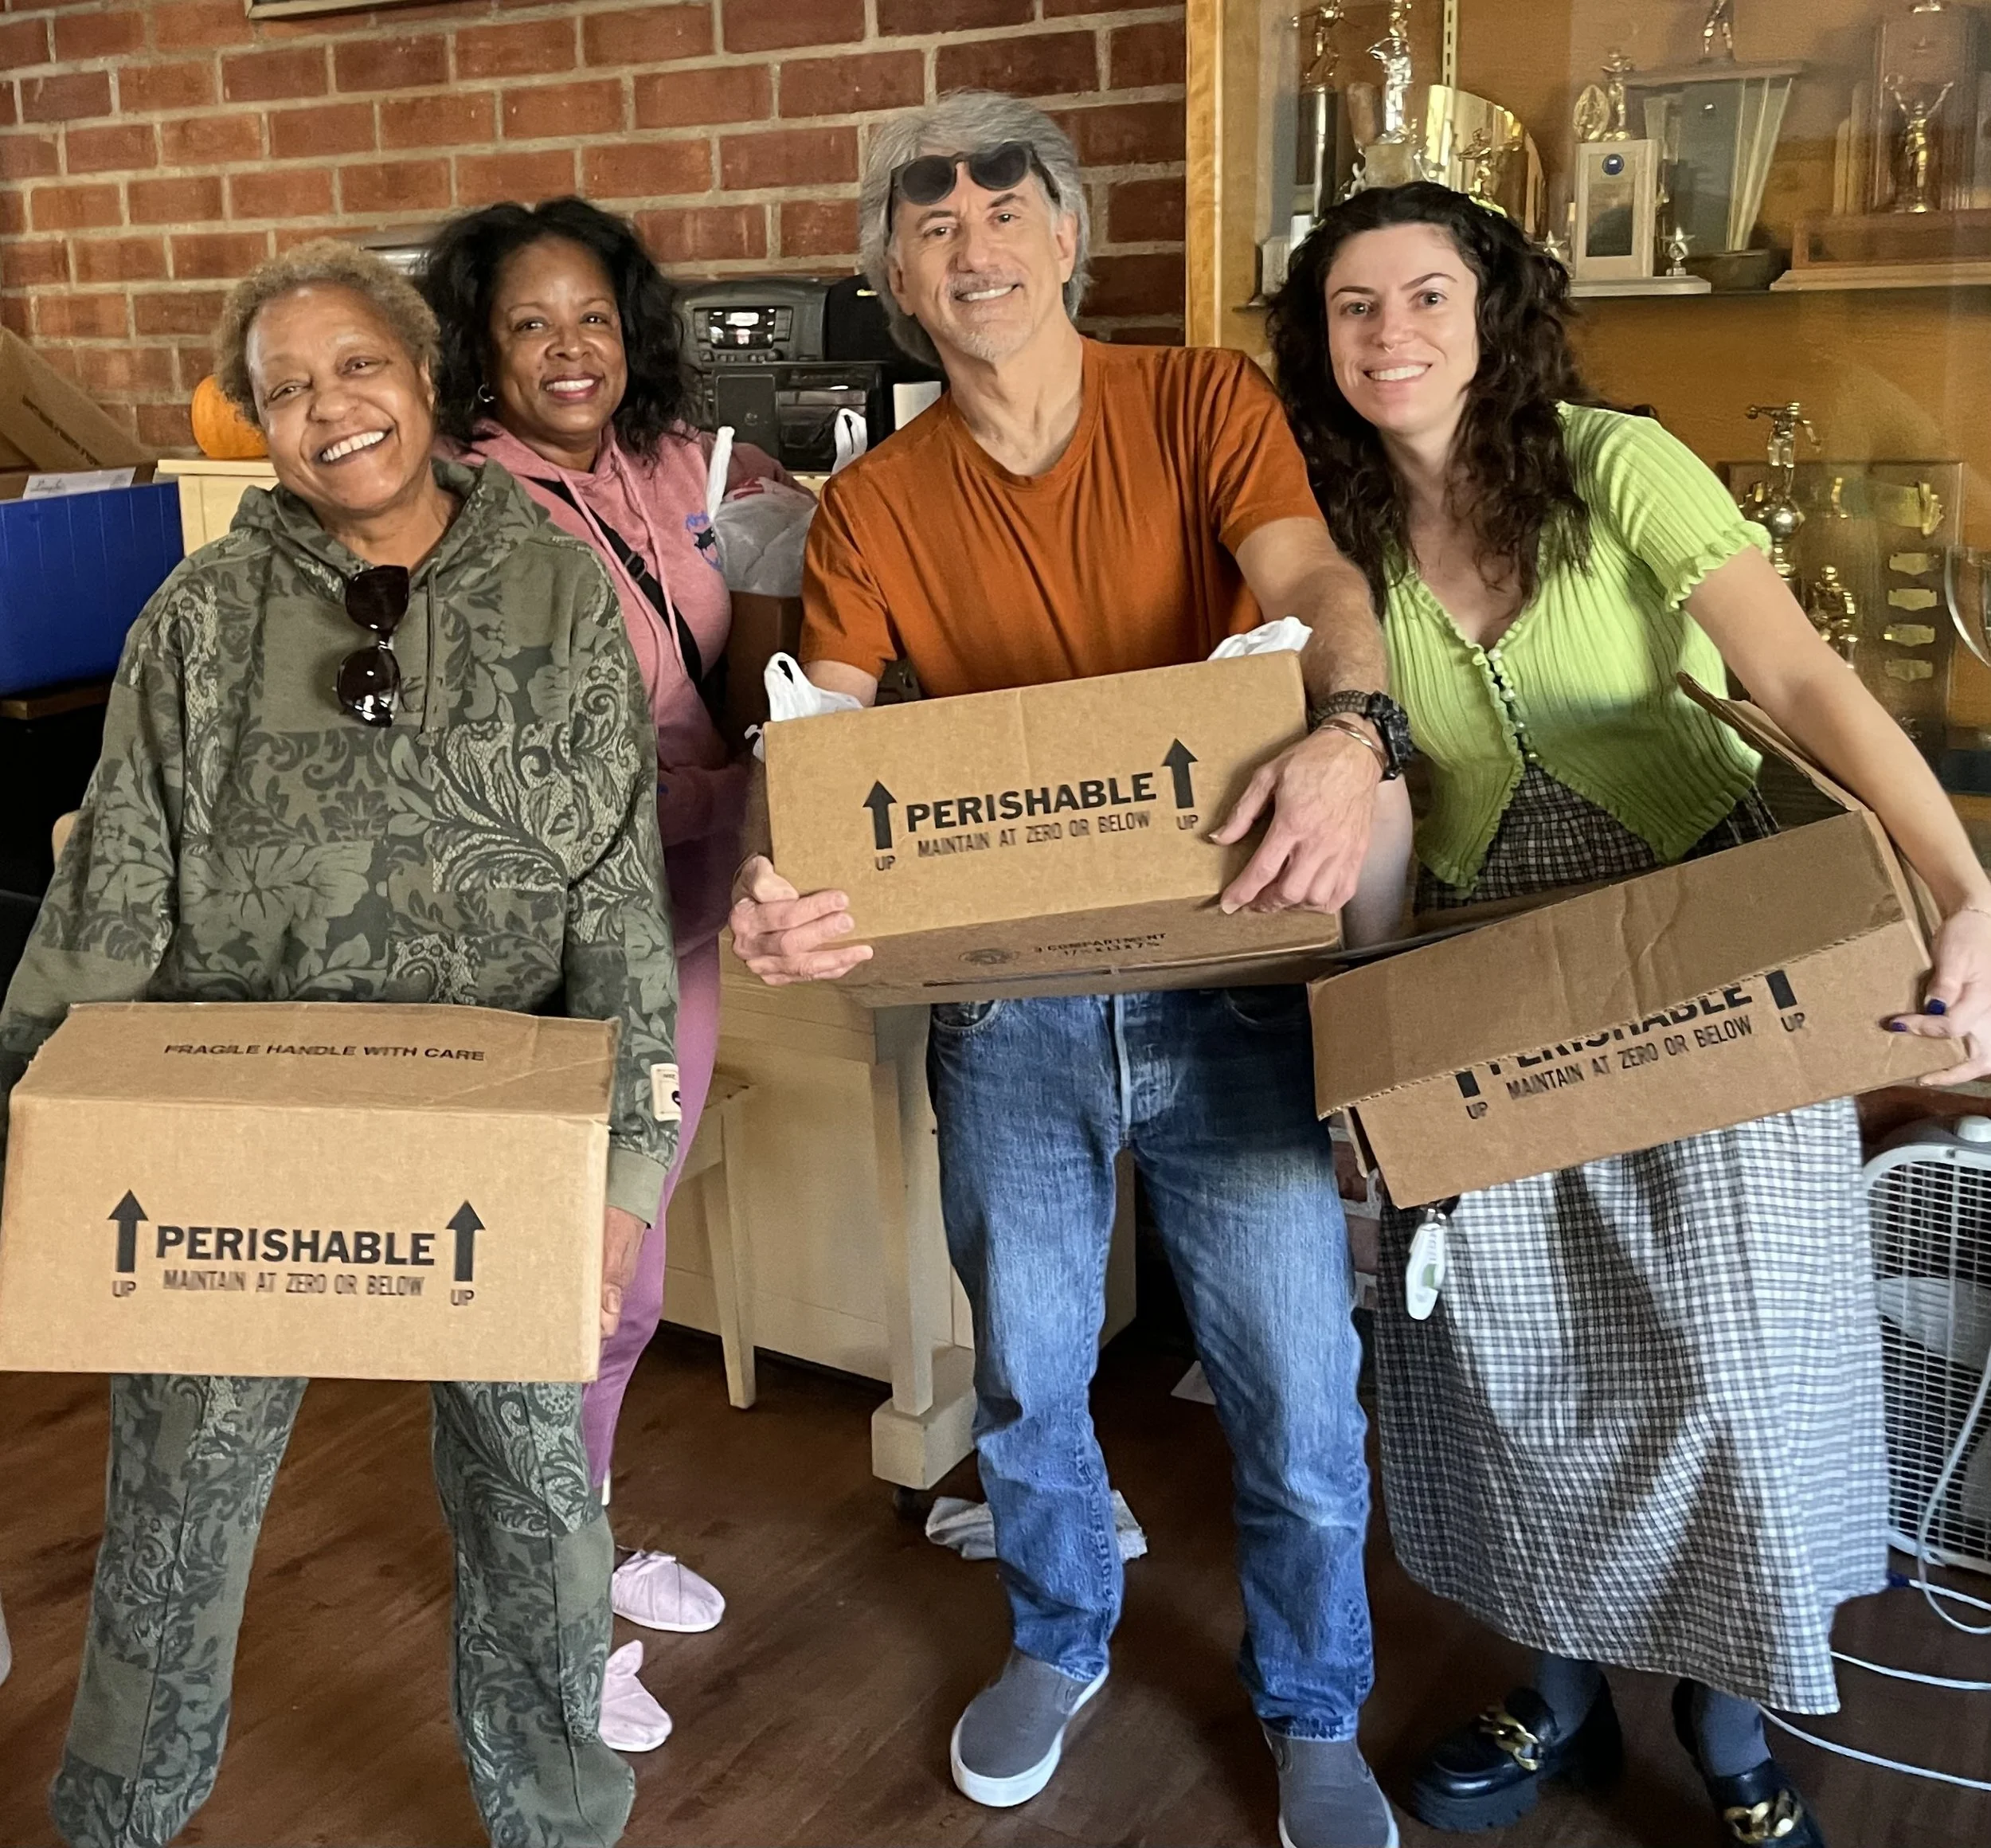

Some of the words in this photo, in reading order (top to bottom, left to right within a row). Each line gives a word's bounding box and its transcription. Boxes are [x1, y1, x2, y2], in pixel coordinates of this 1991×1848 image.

[906, 772, 1156, 832] PERISHABLE
[1177, 814, 1199, 830] UP
[917, 832, 990, 857] MAINTAIN
[999, 828, 1016, 848] AT
[1026, 822, 1062, 844] ZERO
[1069, 819, 1089, 837] OR
[1098, 810, 1151, 833] BELOW
[875, 855, 896, 871] UP
[1781, 1012, 1806, 1033] UP
[165, 1044, 260, 1055] FRAGILE
[266, 1045, 358, 1056] HANDLE
[363, 1046, 417, 1057] WITH
[424, 1047, 485, 1061] CARE
[1506, 1063, 1586, 1100] MAINTAIN
[1592, 1055, 1611, 1078] AT
[1617, 1043, 1658, 1070] ZERO
[1664, 1034, 1688, 1056] OR
[1694, 1016, 1753, 1048] BELOW
[1465, 1102, 1488, 1120] UP
[156, 1226, 436, 1266] PERISHABLE
[112, 1281, 136, 1298] UP
[163, 1270, 246, 1291] MAINTAIN
[256, 1272, 277, 1293] AT
[286, 1272, 327, 1294] ZERO
[334, 1274, 358, 1294] OR
[366, 1274, 425, 1296] BELOW
[451, 1289, 475, 1306] UP
